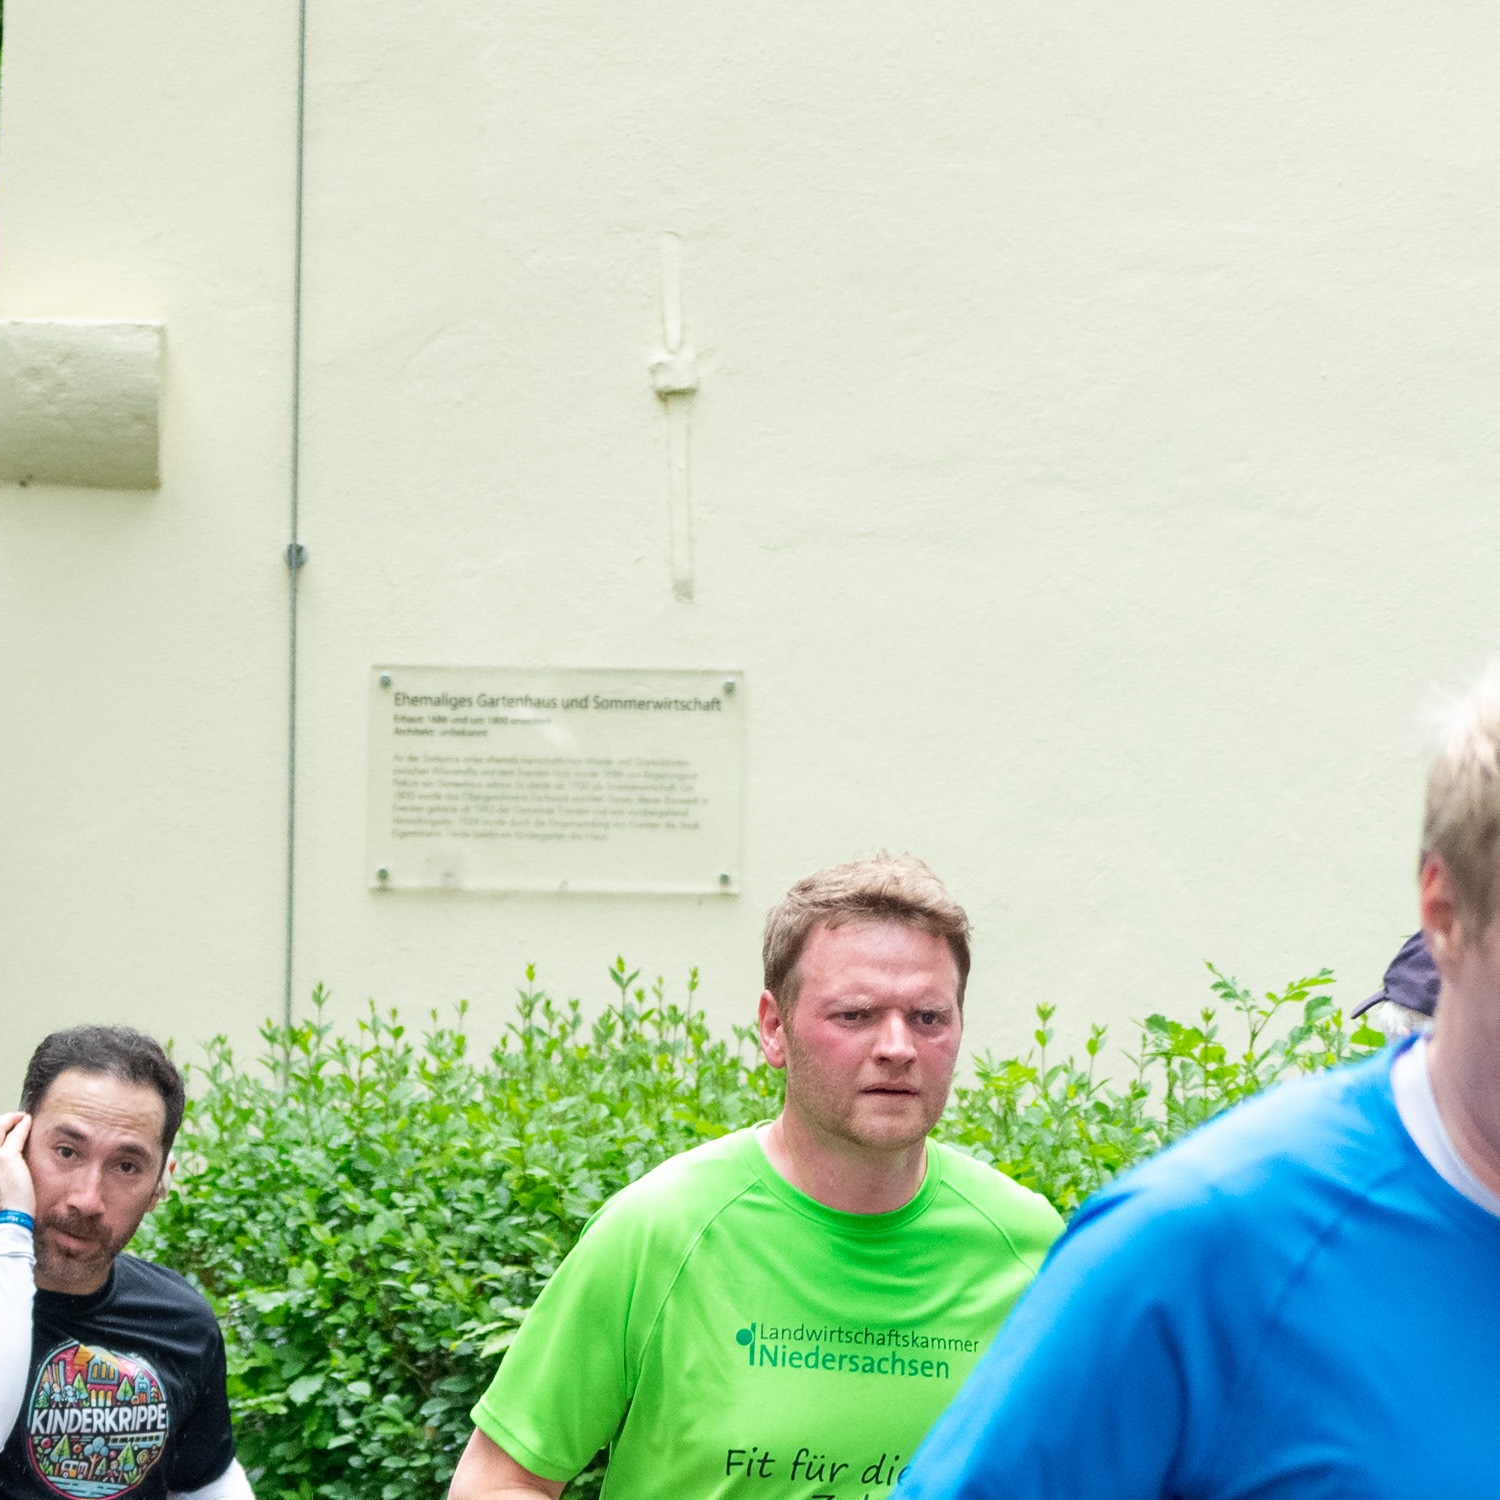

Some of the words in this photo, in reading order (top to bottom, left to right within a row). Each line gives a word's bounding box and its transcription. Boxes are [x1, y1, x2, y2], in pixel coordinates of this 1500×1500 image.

[394, 692, 473, 710] Ehemaliges
[476, 694, 557, 709] Gartenhaus
[561, 696, 588, 709] und
[592, 696, 721, 711] Sommerwirtschaft
[760, 1323, 979, 1353] Landwirtschaftskammer
[759, 1344, 949, 1379] Niedersachsen
[30, 1403, 167, 1435] KINDERKRIPPE
[726, 1447, 775, 1478] Fit
[790, 1448, 849, 1483] für
